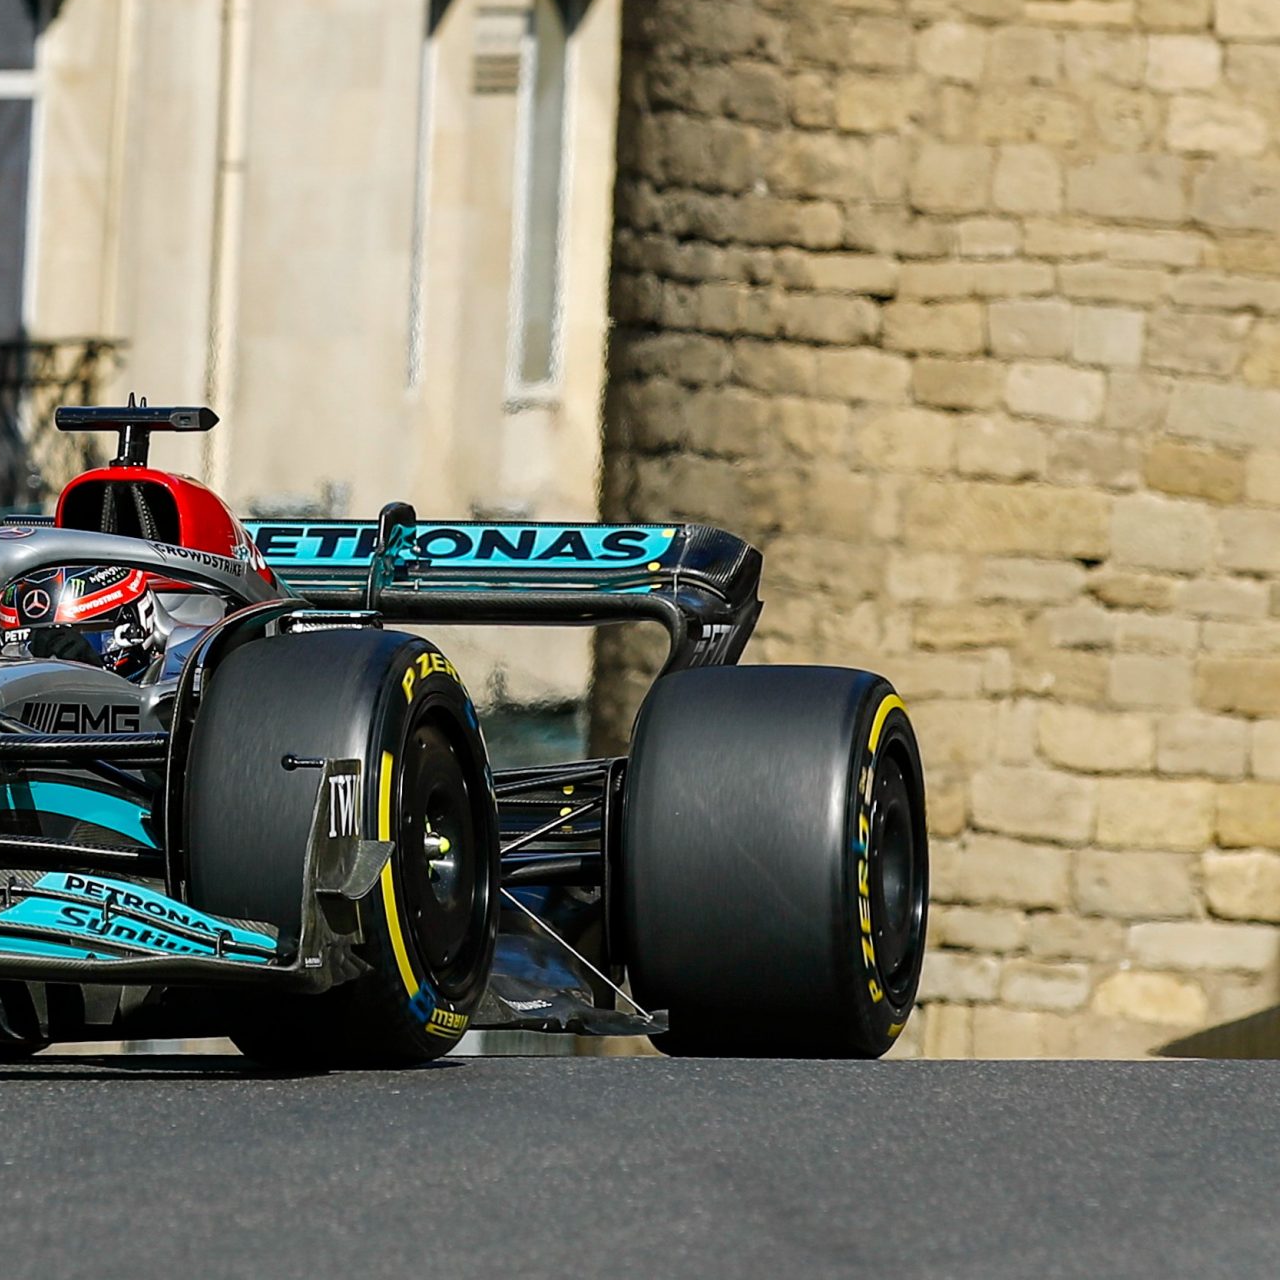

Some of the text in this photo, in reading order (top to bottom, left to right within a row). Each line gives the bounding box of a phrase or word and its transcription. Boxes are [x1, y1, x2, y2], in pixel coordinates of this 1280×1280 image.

[245, 526, 650, 561] ETONAS
[155, 543, 243, 577] CROWDSTRIKE
[416, 652, 462, 682] ZER
[51, 704, 140, 734] AMG
